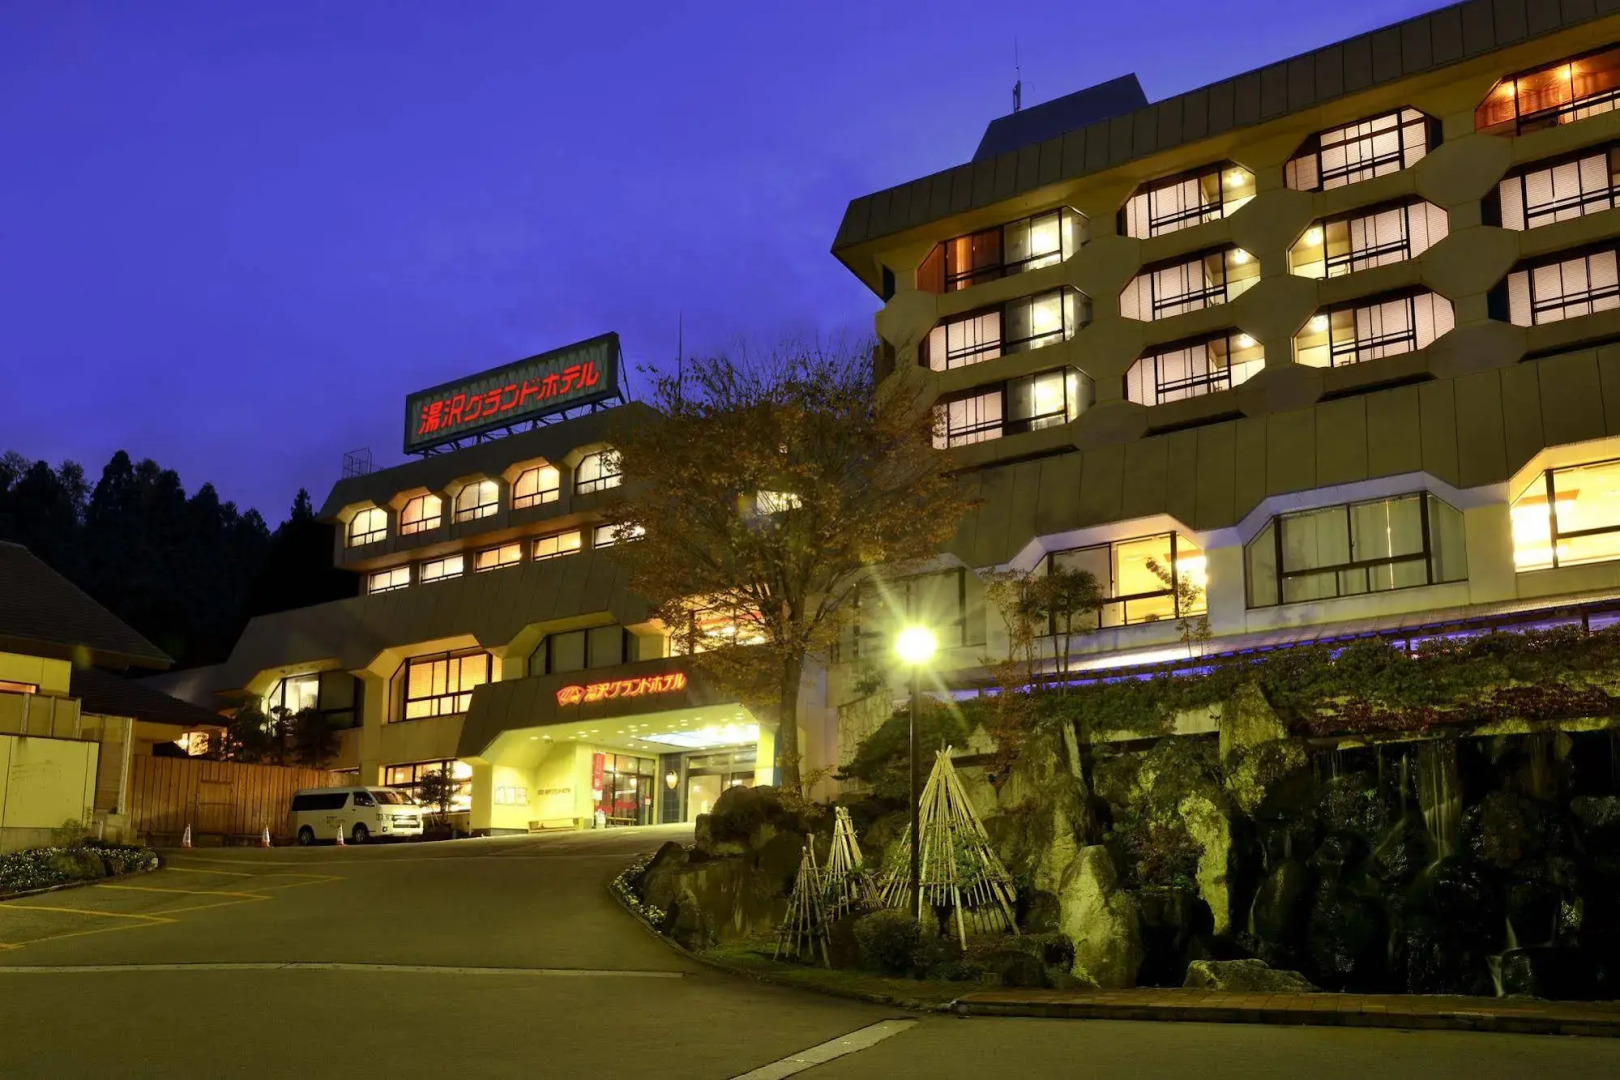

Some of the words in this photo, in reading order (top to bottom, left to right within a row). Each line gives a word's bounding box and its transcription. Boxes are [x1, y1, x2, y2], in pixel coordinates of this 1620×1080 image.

[418, 360, 600, 435] 湯沢グランドホテル
[584, 672, 687, 703] 湯沢グランドホテル
